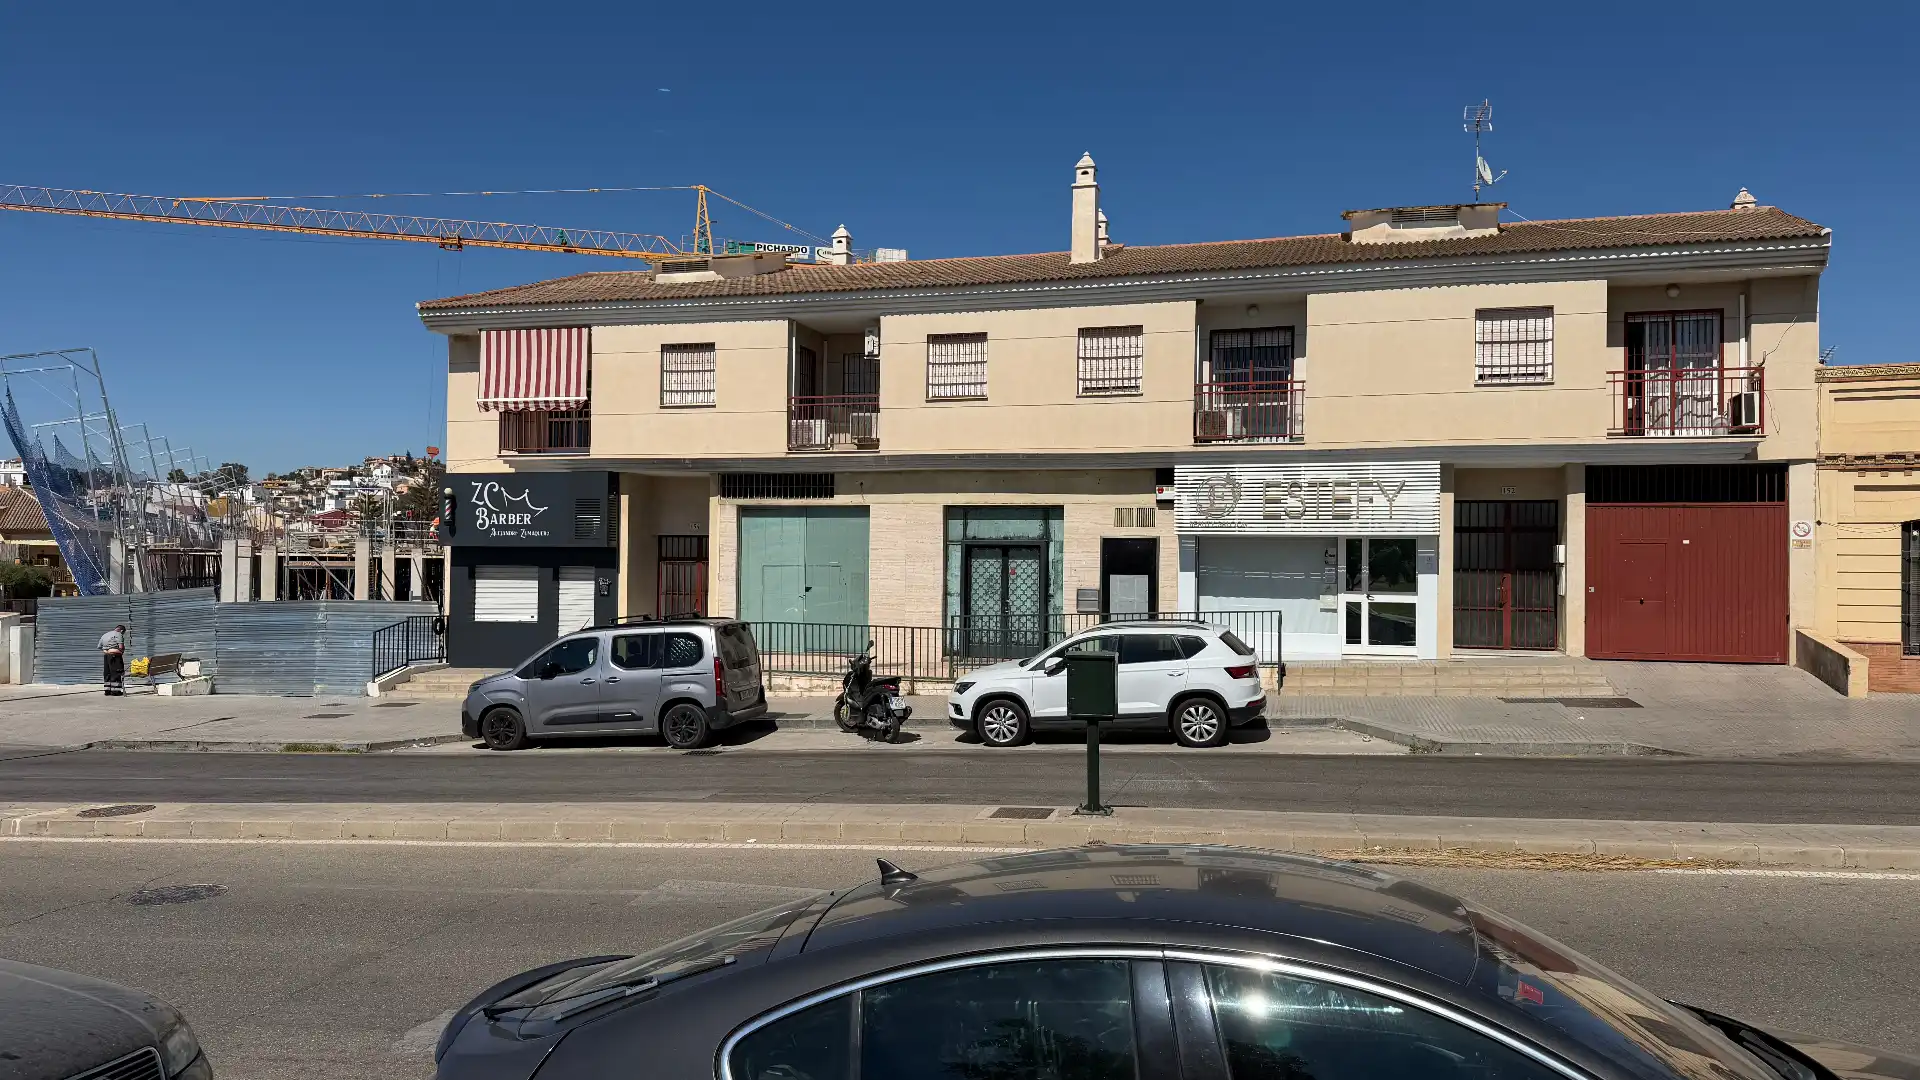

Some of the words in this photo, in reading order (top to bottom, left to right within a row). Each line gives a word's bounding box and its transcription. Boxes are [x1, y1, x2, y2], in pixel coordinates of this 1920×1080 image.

[756, 243, 807, 253] PICHARDO
[1263, 479, 1406, 519] ESTEFY
[1503, 487, 1516, 495] 152
[475, 507, 532, 530] BARBER
